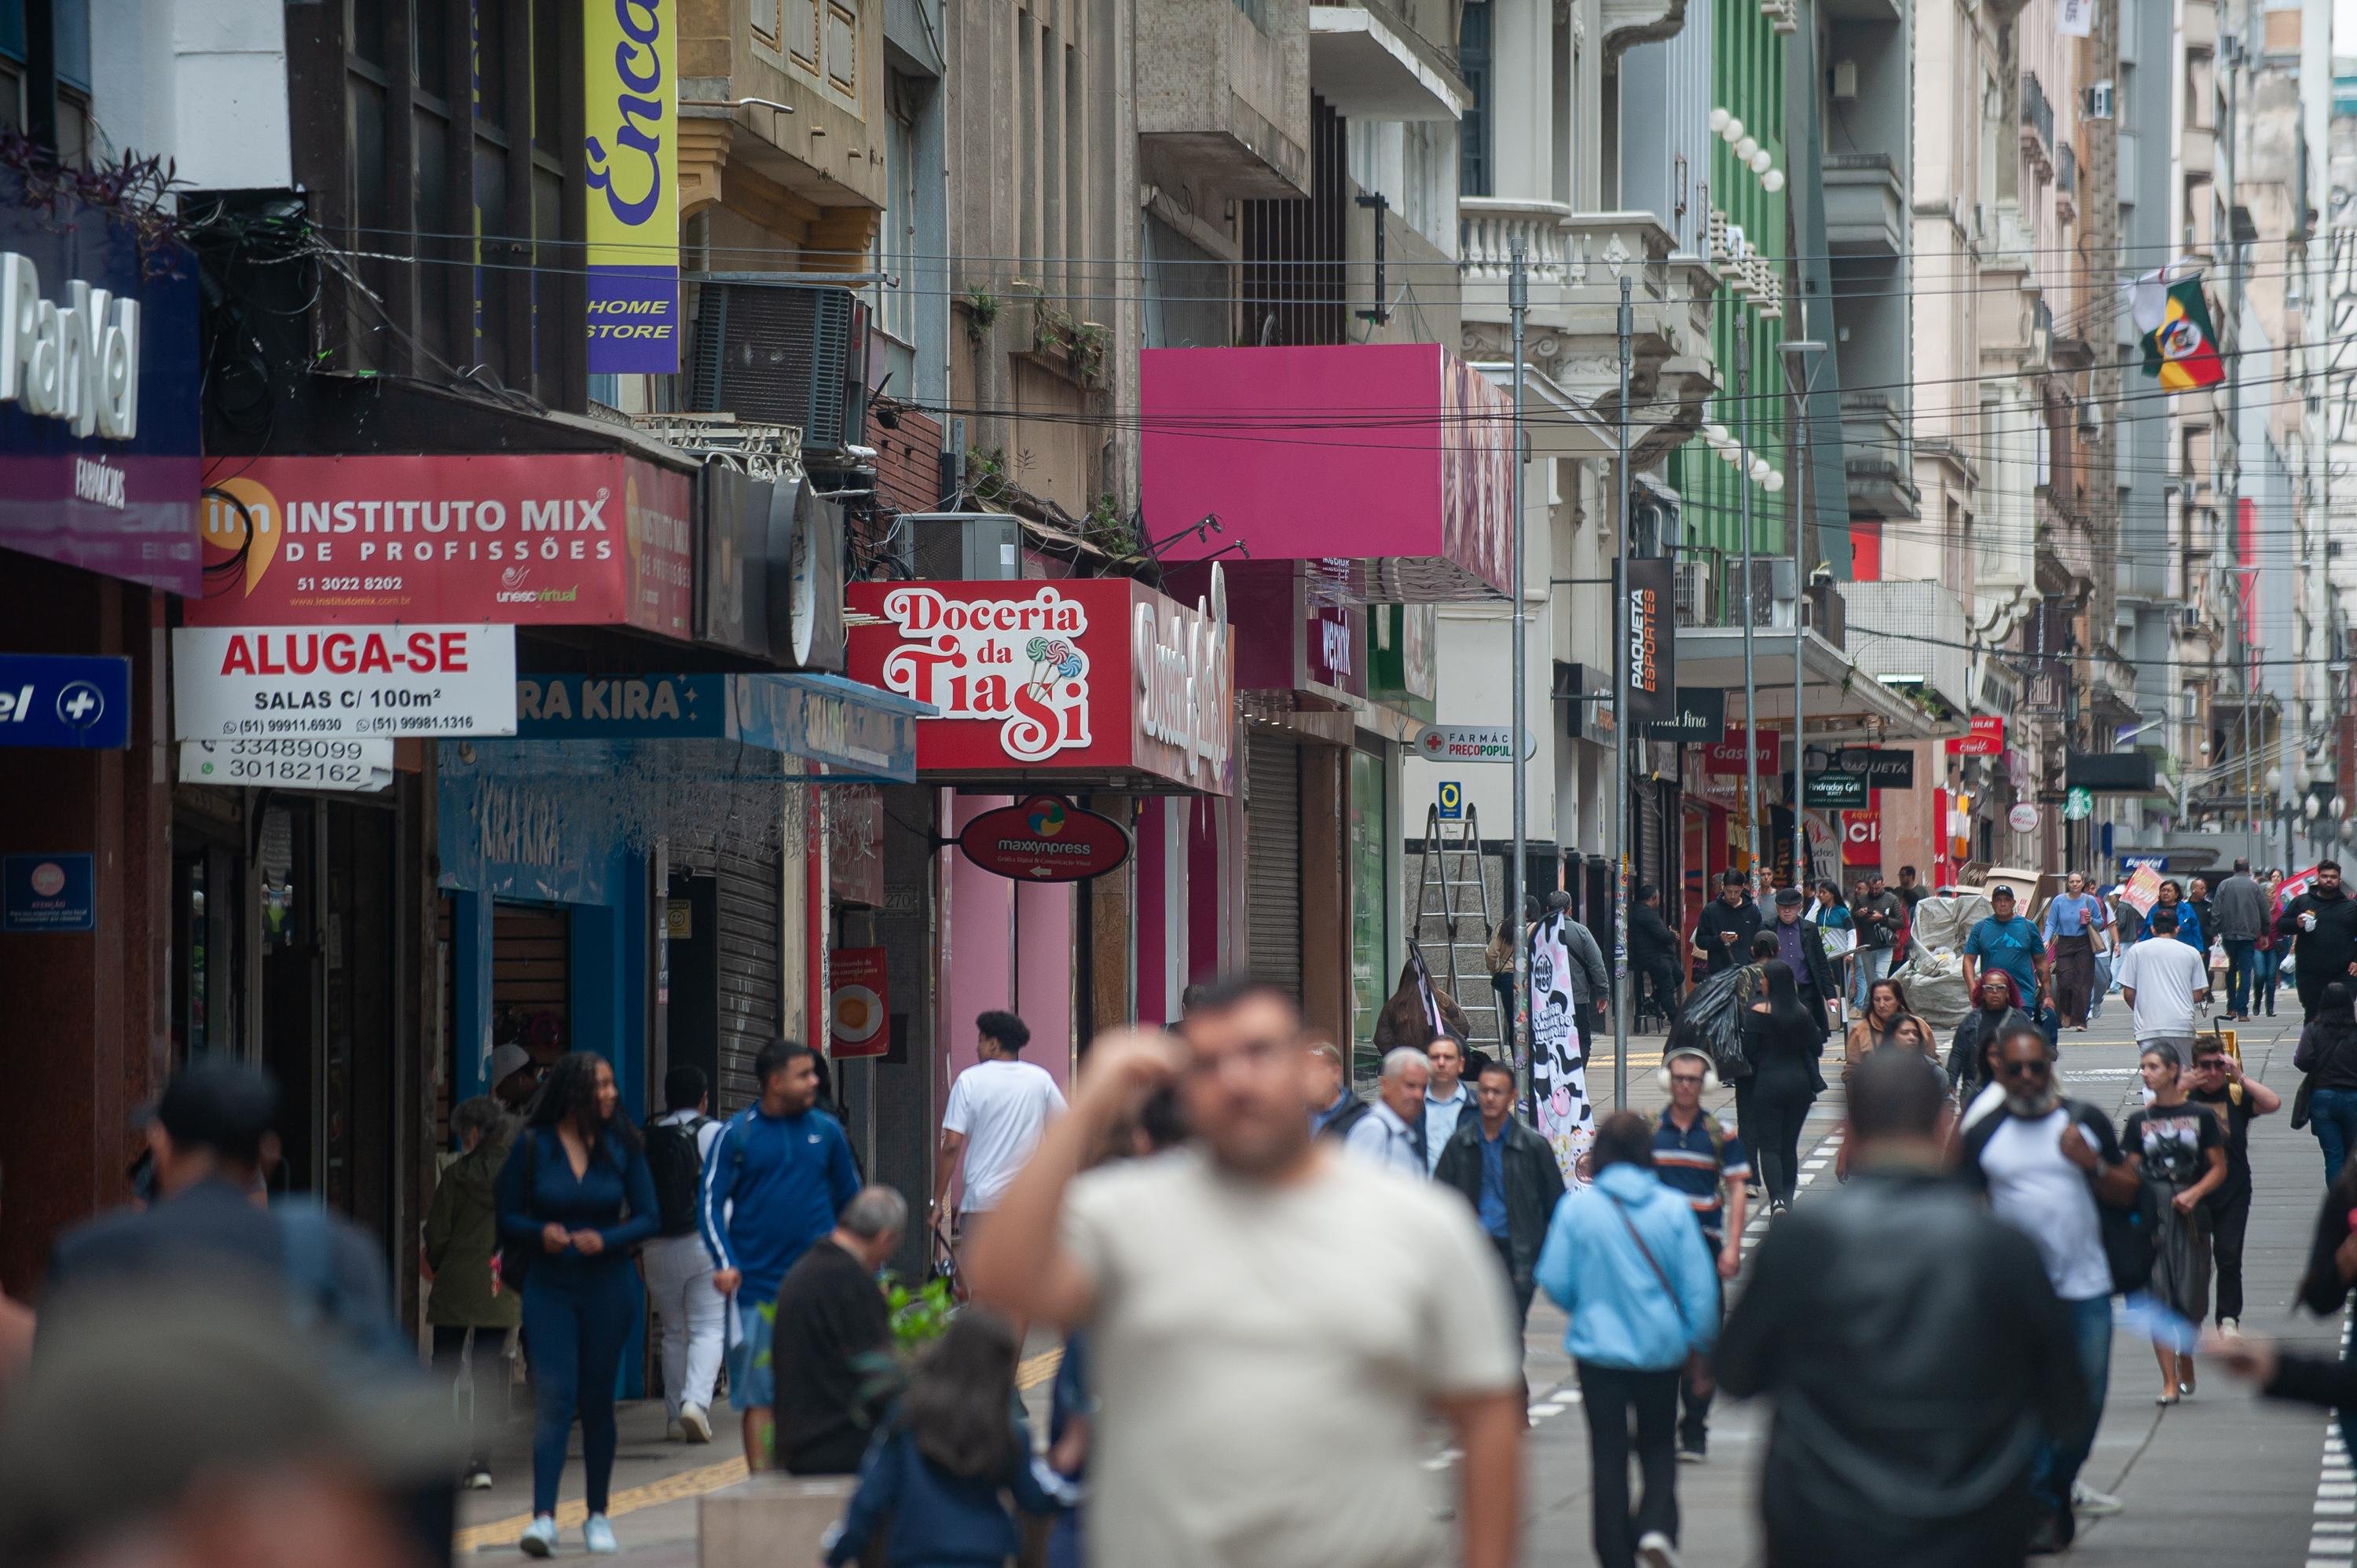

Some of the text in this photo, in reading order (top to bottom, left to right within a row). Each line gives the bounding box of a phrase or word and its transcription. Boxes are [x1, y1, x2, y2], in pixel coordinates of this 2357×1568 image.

[588, 300, 669, 314] HOME
[588, 325, 673, 339] STORE
[286, 500, 607, 533] INSTITUTO MIX
[286, 537, 612, 562] DE PROFISSÕES
[297, 577, 403, 591] 51 3022 8202
[891, 594, 1080, 631] Doceria
[977, 638, 1014, 664] da
[1644, 589, 1655, 693] ESPORTES
[220, 631, 468, 676] ALUGA-SE
[254, 689, 441, 710] SALAS C/ 100m²
[517, 680, 680, 720] RA KIRA
[889, 634, 1085, 753] Tia Si
[240, 720, 265, 735] (51)
[268, 719, 342, 732] 99911.6930
[372, 716, 397, 733] (51)
[1970, 719, 1995, 728] LULAR
[1449, 732, 1508, 743] FARMÁC
[230, 739, 362, 760] 33489099
[1449, 744, 1514, 757] PREÇOPOPUL
[1713, 744, 1771, 760] Gasn
[229, 760, 361, 783] 30182162
[998, 839, 1091, 855] maxxynpress
